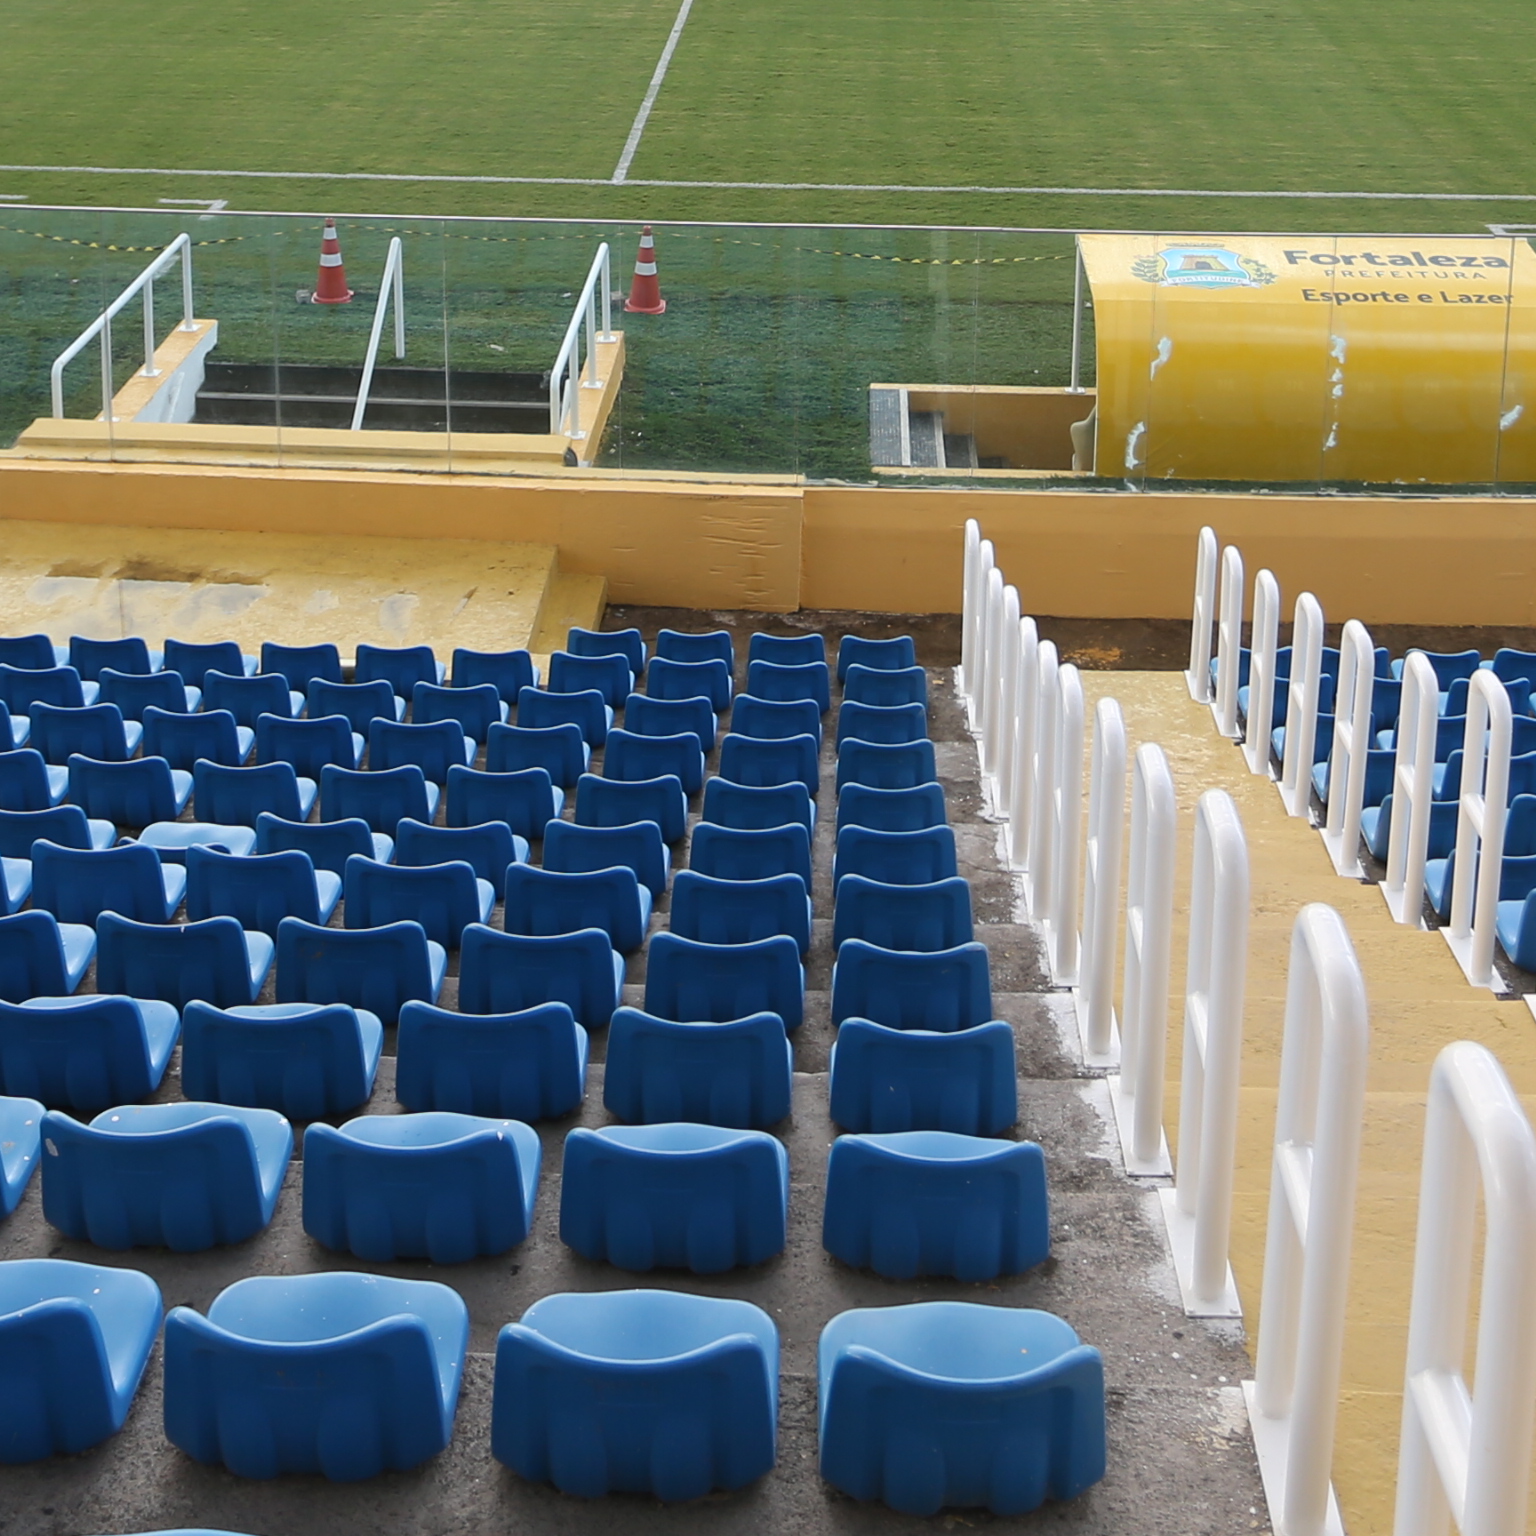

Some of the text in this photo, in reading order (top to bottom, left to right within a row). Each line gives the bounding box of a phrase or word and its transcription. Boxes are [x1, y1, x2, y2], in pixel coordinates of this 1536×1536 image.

[1282, 250, 1510, 269] Fortaleza
[1323, 268, 1488, 281] PREFEITURA
[1301, 288, 1514, 307] Esporte e Lazer
